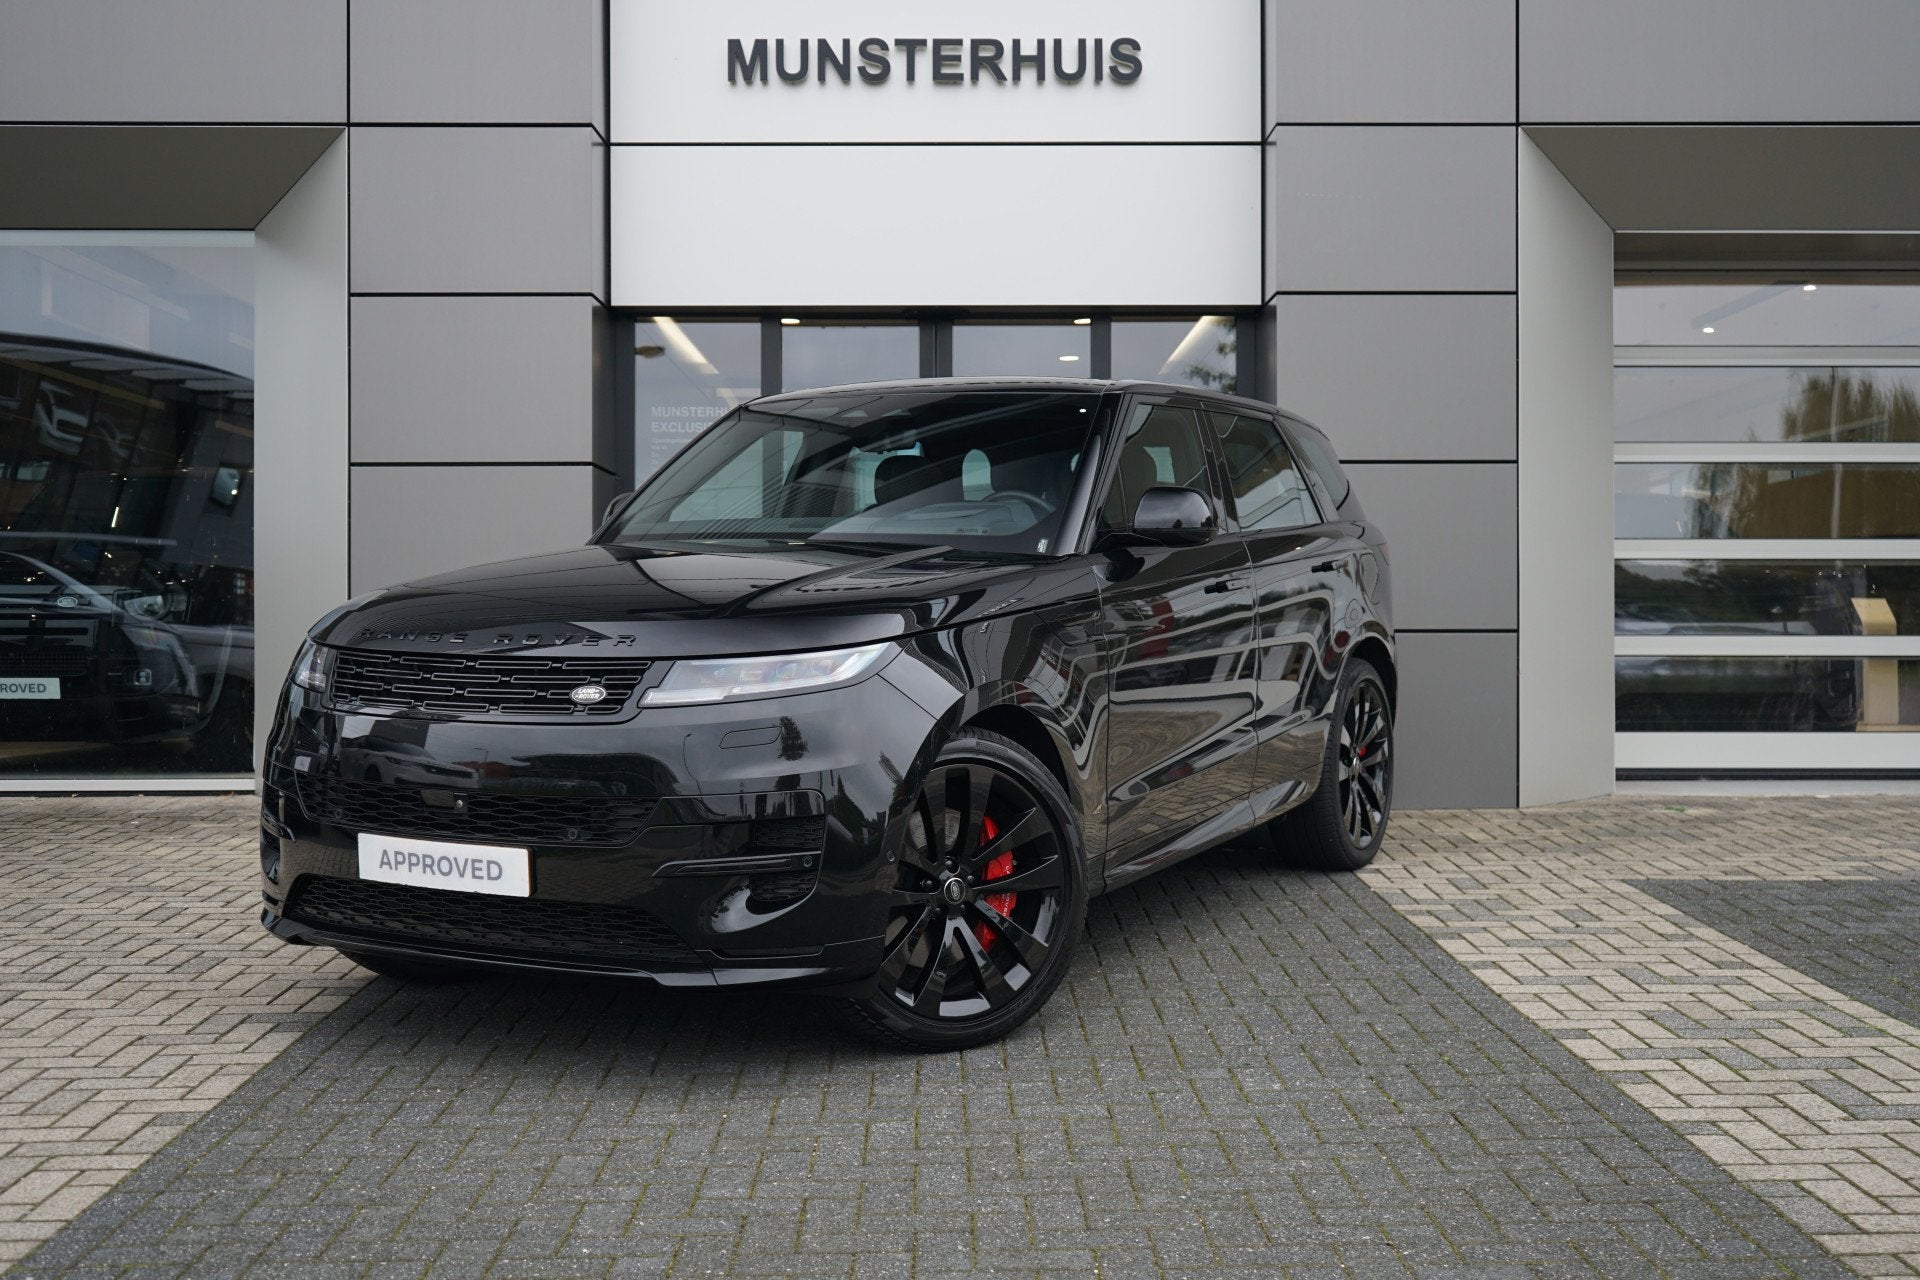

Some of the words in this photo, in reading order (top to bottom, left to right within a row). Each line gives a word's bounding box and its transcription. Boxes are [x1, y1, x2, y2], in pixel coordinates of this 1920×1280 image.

[727, 37, 1143, 83] MUNSTERHUIS
[651, 406, 728, 418] MUNSTERH
[358, 627, 469, 643] RANGE
[492, 633, 636, 647] ROVER
[379, 849, 503, 881] APPROVED
